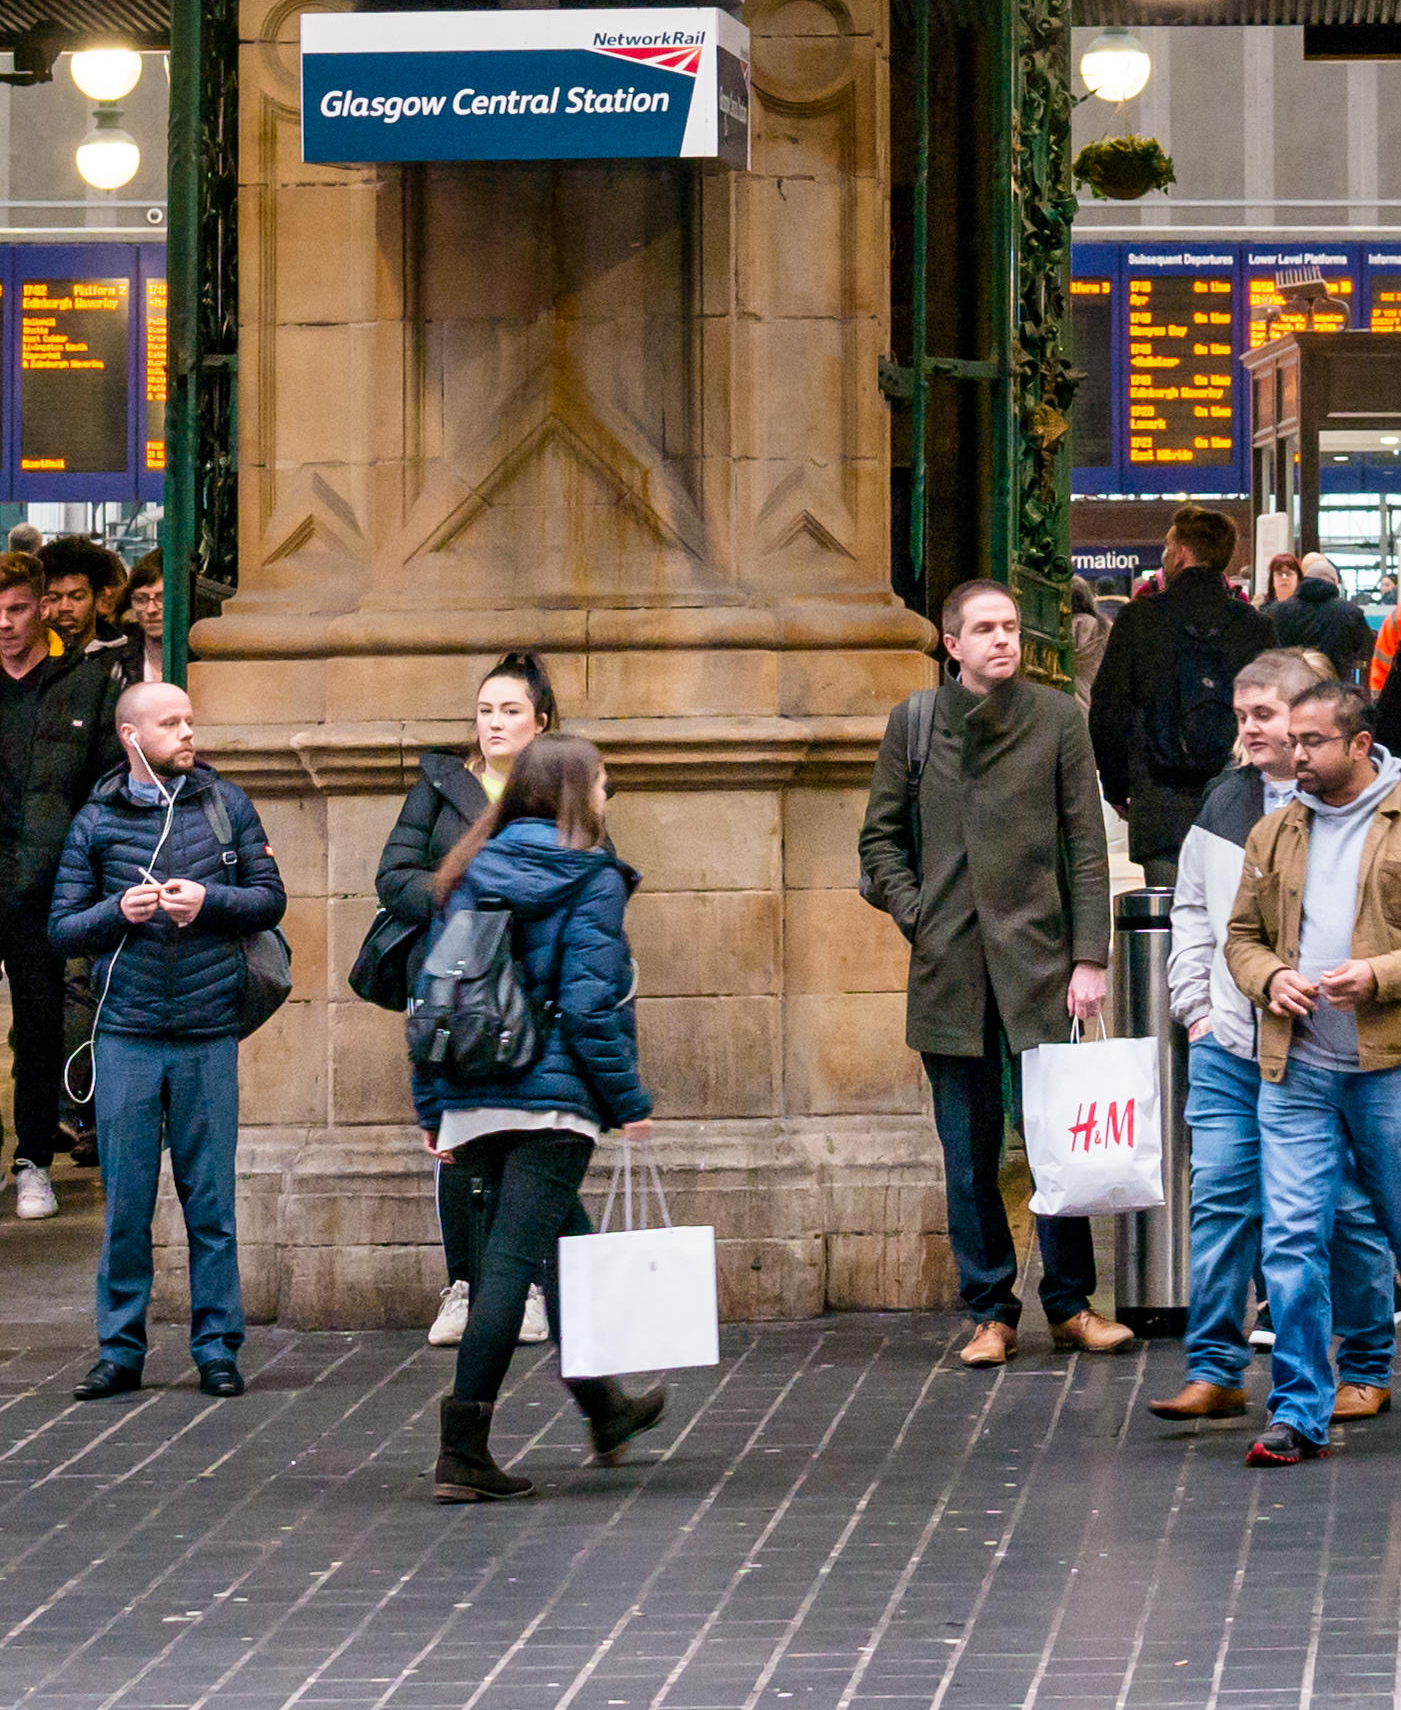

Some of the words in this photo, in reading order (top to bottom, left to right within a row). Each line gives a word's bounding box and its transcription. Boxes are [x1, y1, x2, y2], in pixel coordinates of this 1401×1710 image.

[320, 90, 447, 123] Glasgow
[452, 87, 560, 116] Central
[564, 87, 669, 114] Station
[1128, 253, 1182, 267] Subsequent
[1184, 253, 1234, 267] Departures
[1249, 253, 1277, 265] Lower
[1278, 253, 1302, 265] Level
[1304, 253, 1348, 265] Platforms
[1068, 1098, 1135, 1153] H&M
